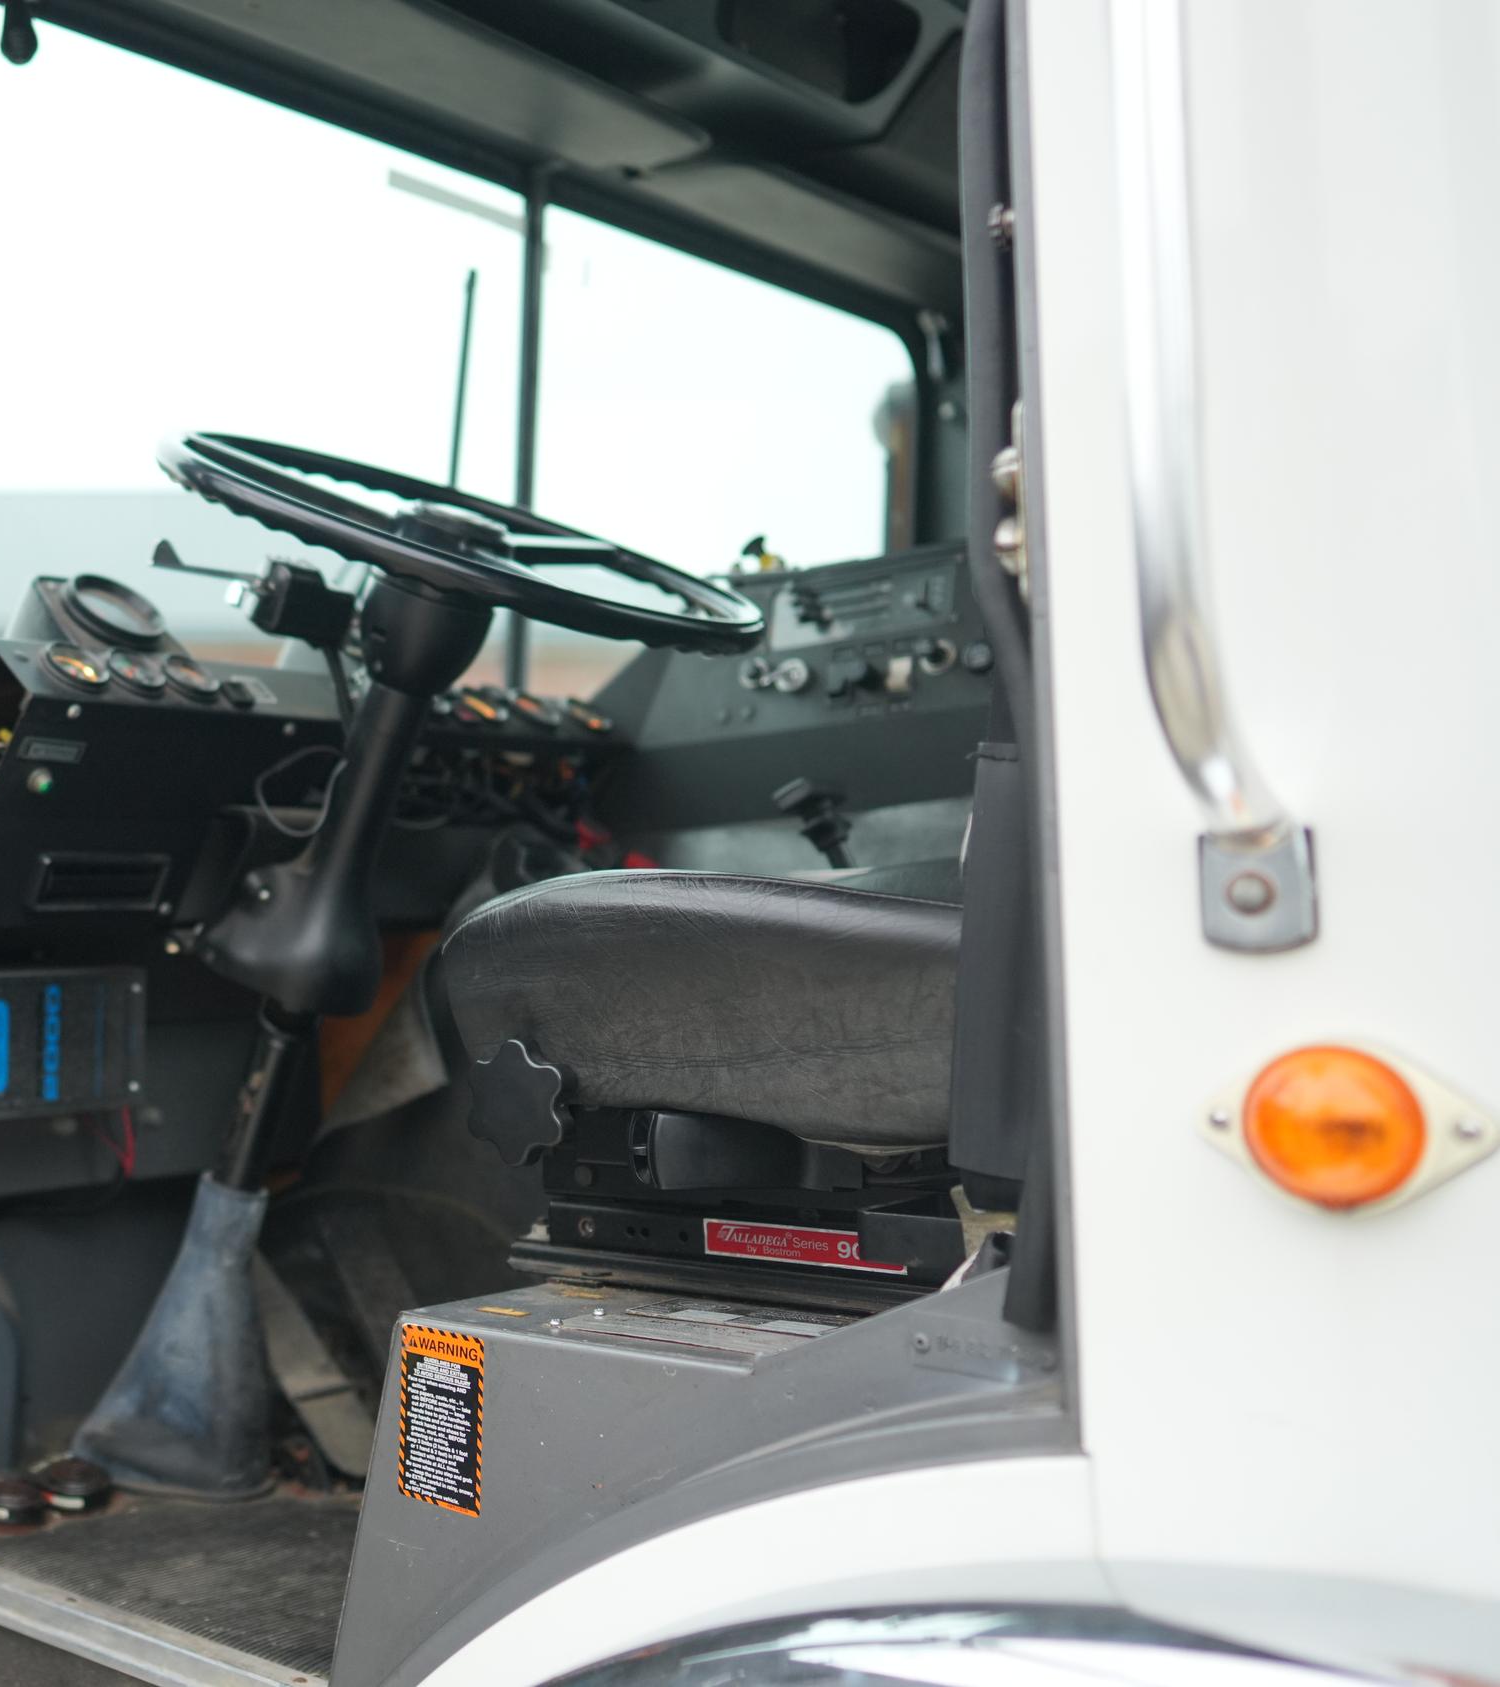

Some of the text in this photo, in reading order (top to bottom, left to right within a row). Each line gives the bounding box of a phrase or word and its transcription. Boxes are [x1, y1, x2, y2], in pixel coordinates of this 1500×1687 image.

[746, 1244, 801, 1258] by Bostrom
[792, 1237, 829, 1251] Series
[419, 1336, 478, 1361] WARNING
